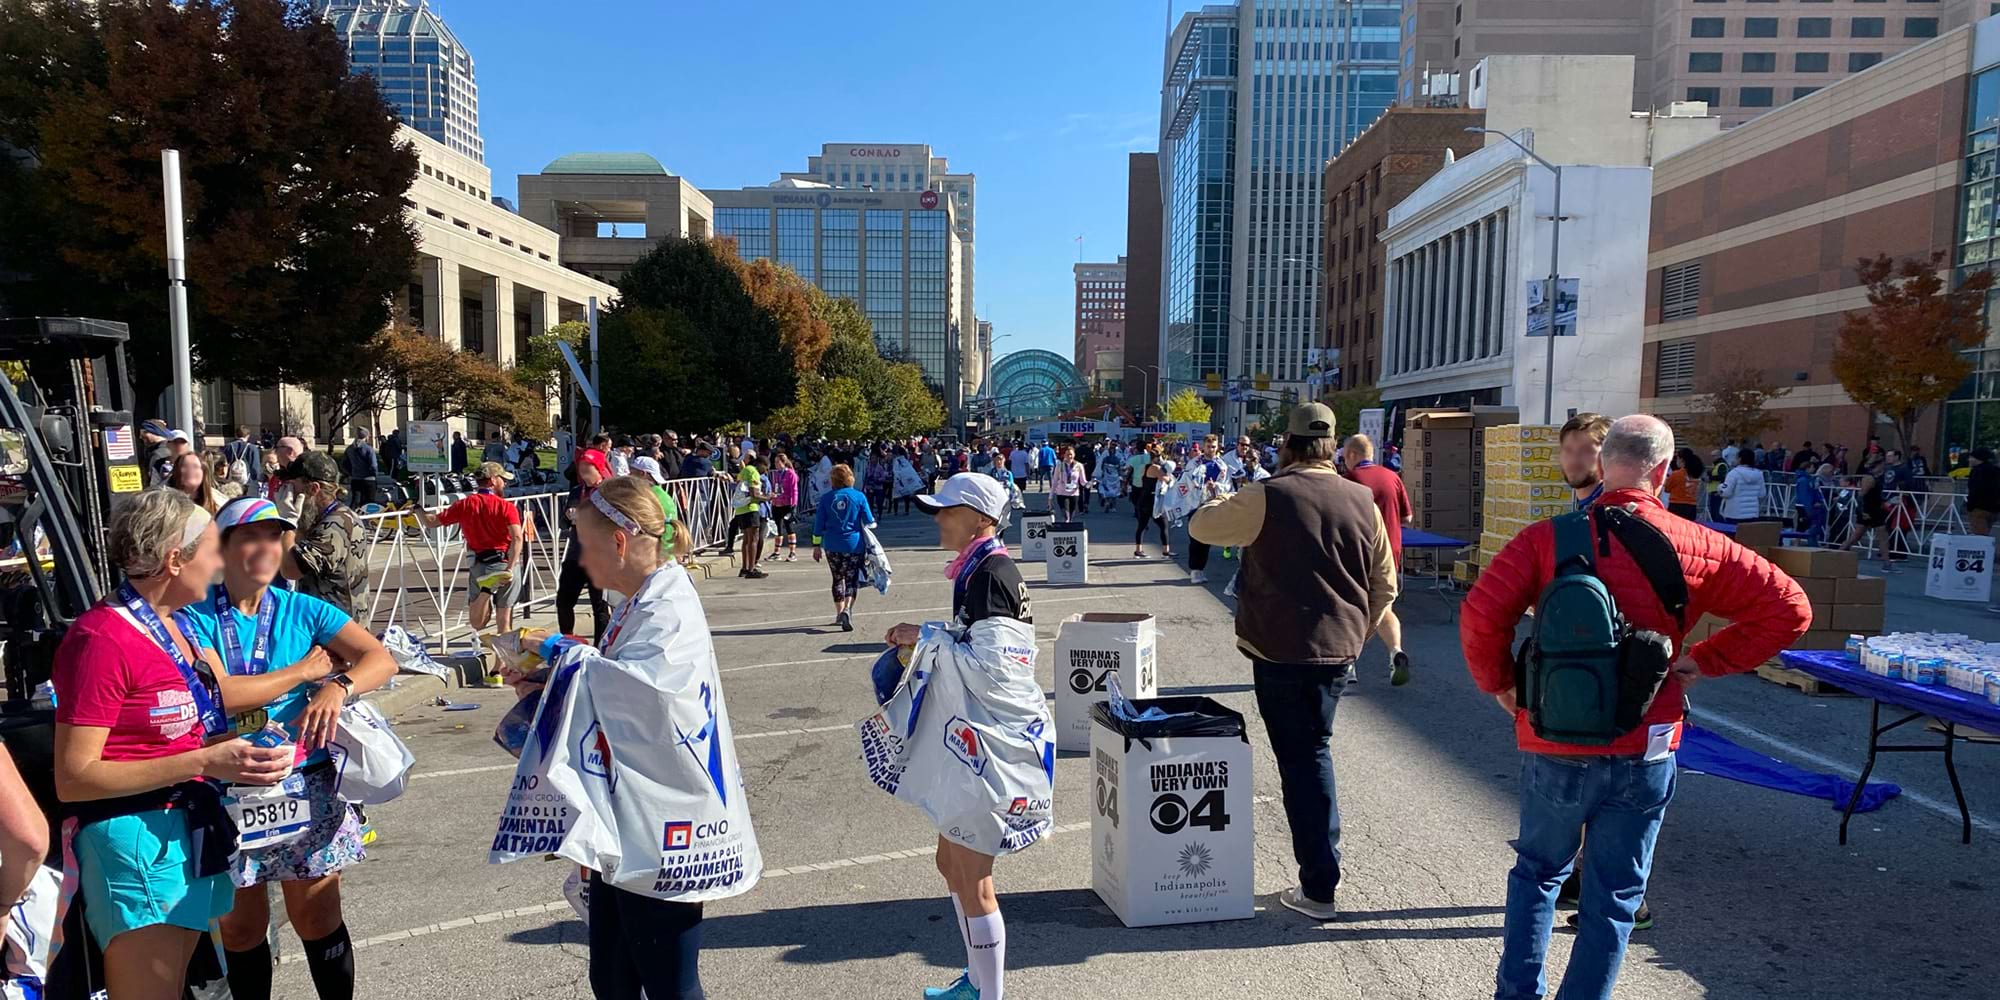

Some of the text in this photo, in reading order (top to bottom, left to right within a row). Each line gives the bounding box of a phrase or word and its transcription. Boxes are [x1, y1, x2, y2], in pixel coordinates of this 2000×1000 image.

[850, 148, 901, 158] CONRAD
[1060, 422, 1095, 433] FINISH
[1037, 529, 1047, 539] 4
[1066, 545, 1078, 557] 4
[1969, 559, 1985, 573] 4
[1070, 649, 1121, 660] INDIANA'S
[1070, 659, 1121, 669] VERY OWN
[865, 720, 901, 785] MONUMNTAL
[1150, 761, 1229, 779] INDIANA'S
[1151, 775, 1229, 792] VERY OWN
[503, 806, 568, 817] NAPOLIS
[1028, 798, 1051, 811] CNO
[1107, 786, 1120, 830] 4
[1189, 790, 1231, 832] 4
[242, 800, 298, 828] D5819
[265, 829, 280, 838] Erin
[696, 819, 729, 839] CNO
[657, 855, 744, 880] MONUMENTAL
[1154, 877, 1227, 892] Indianapolis
